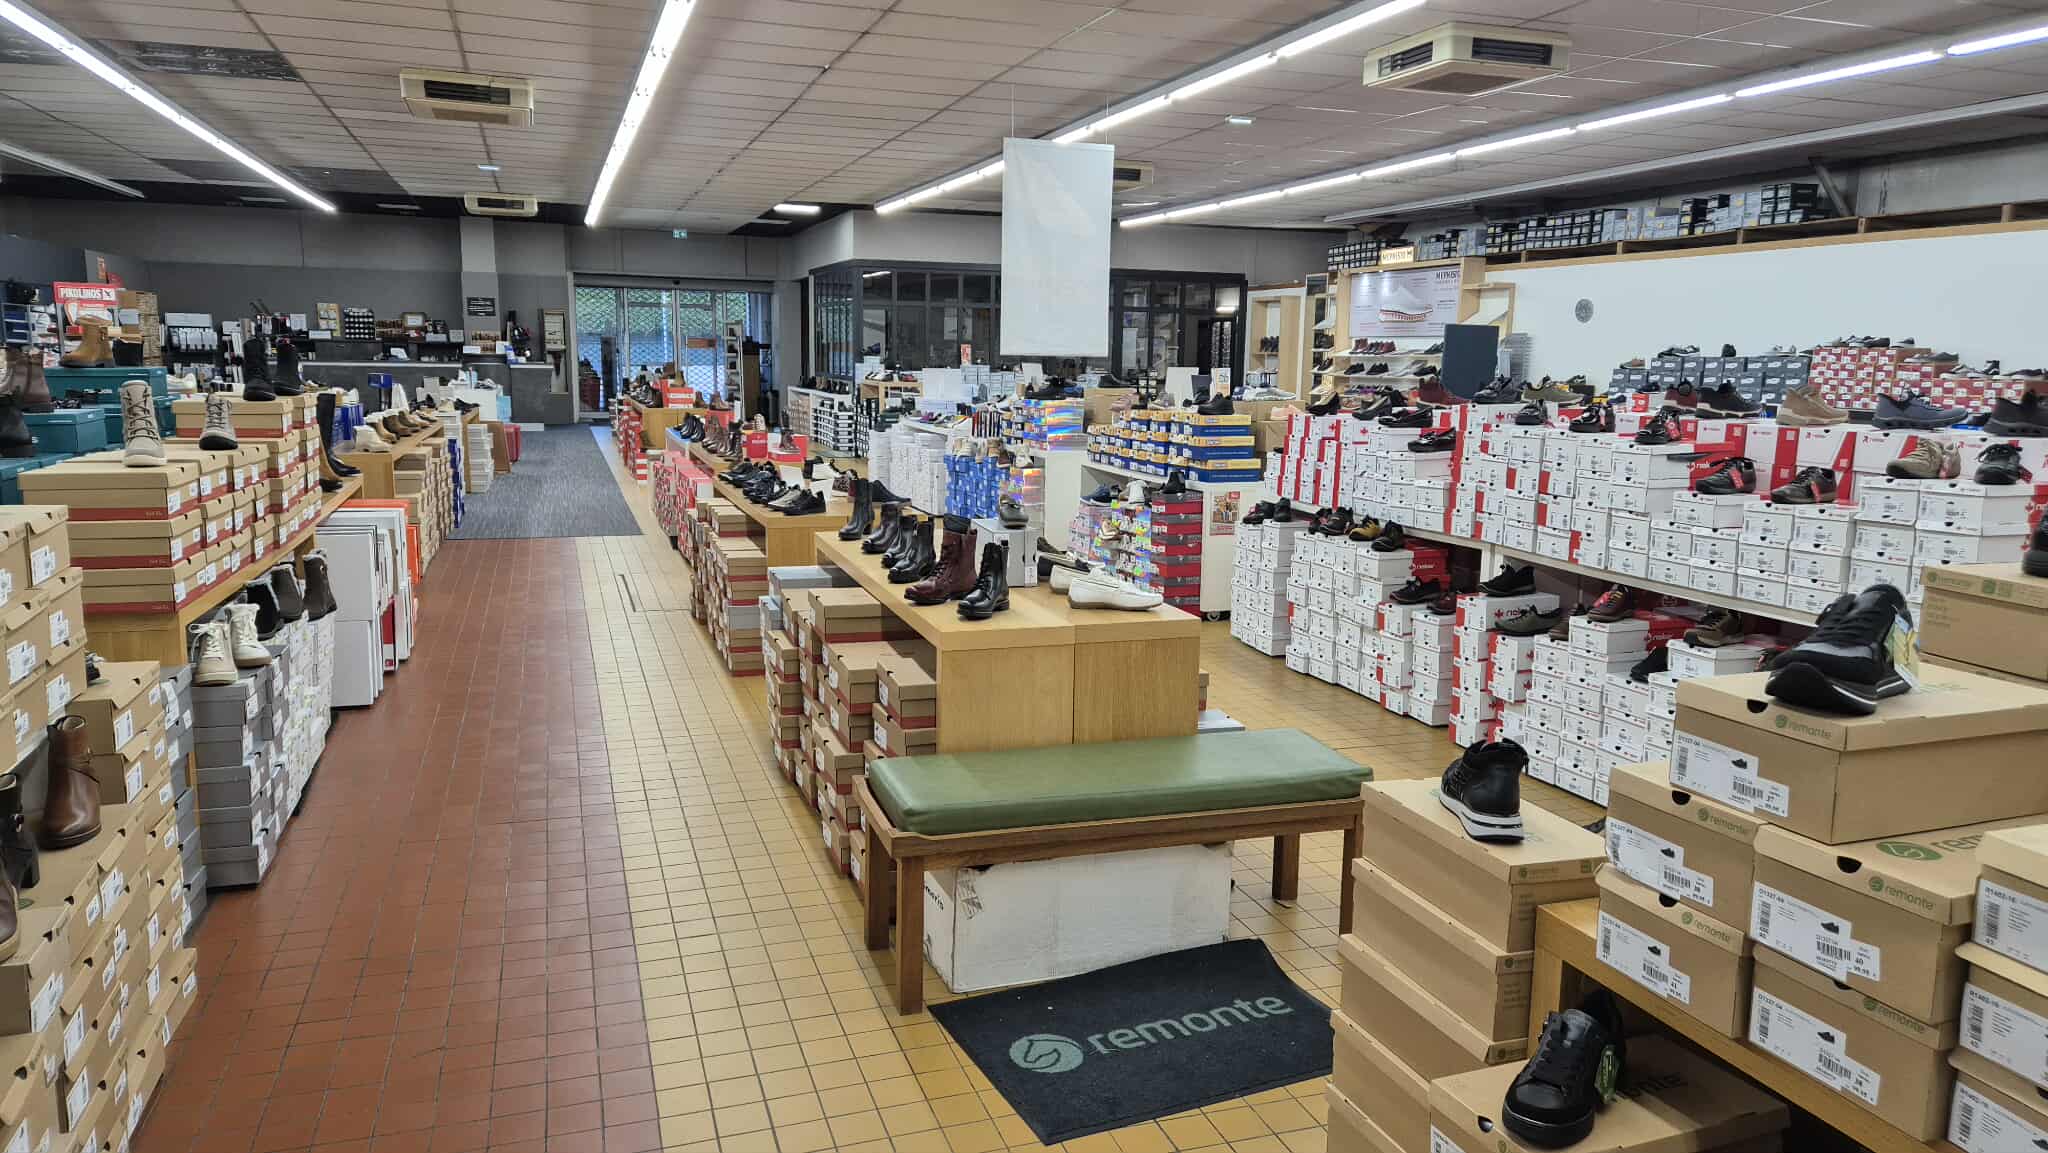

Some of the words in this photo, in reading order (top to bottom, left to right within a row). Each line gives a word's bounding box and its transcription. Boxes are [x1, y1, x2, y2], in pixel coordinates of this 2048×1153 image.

[60, 287, 102, 299] PIKOLINOS
[1885, 885, 1935, 911] remonte
[1695, 919, 1730, 942] remonte
[1087, 997, 1294, 1055] remonte
